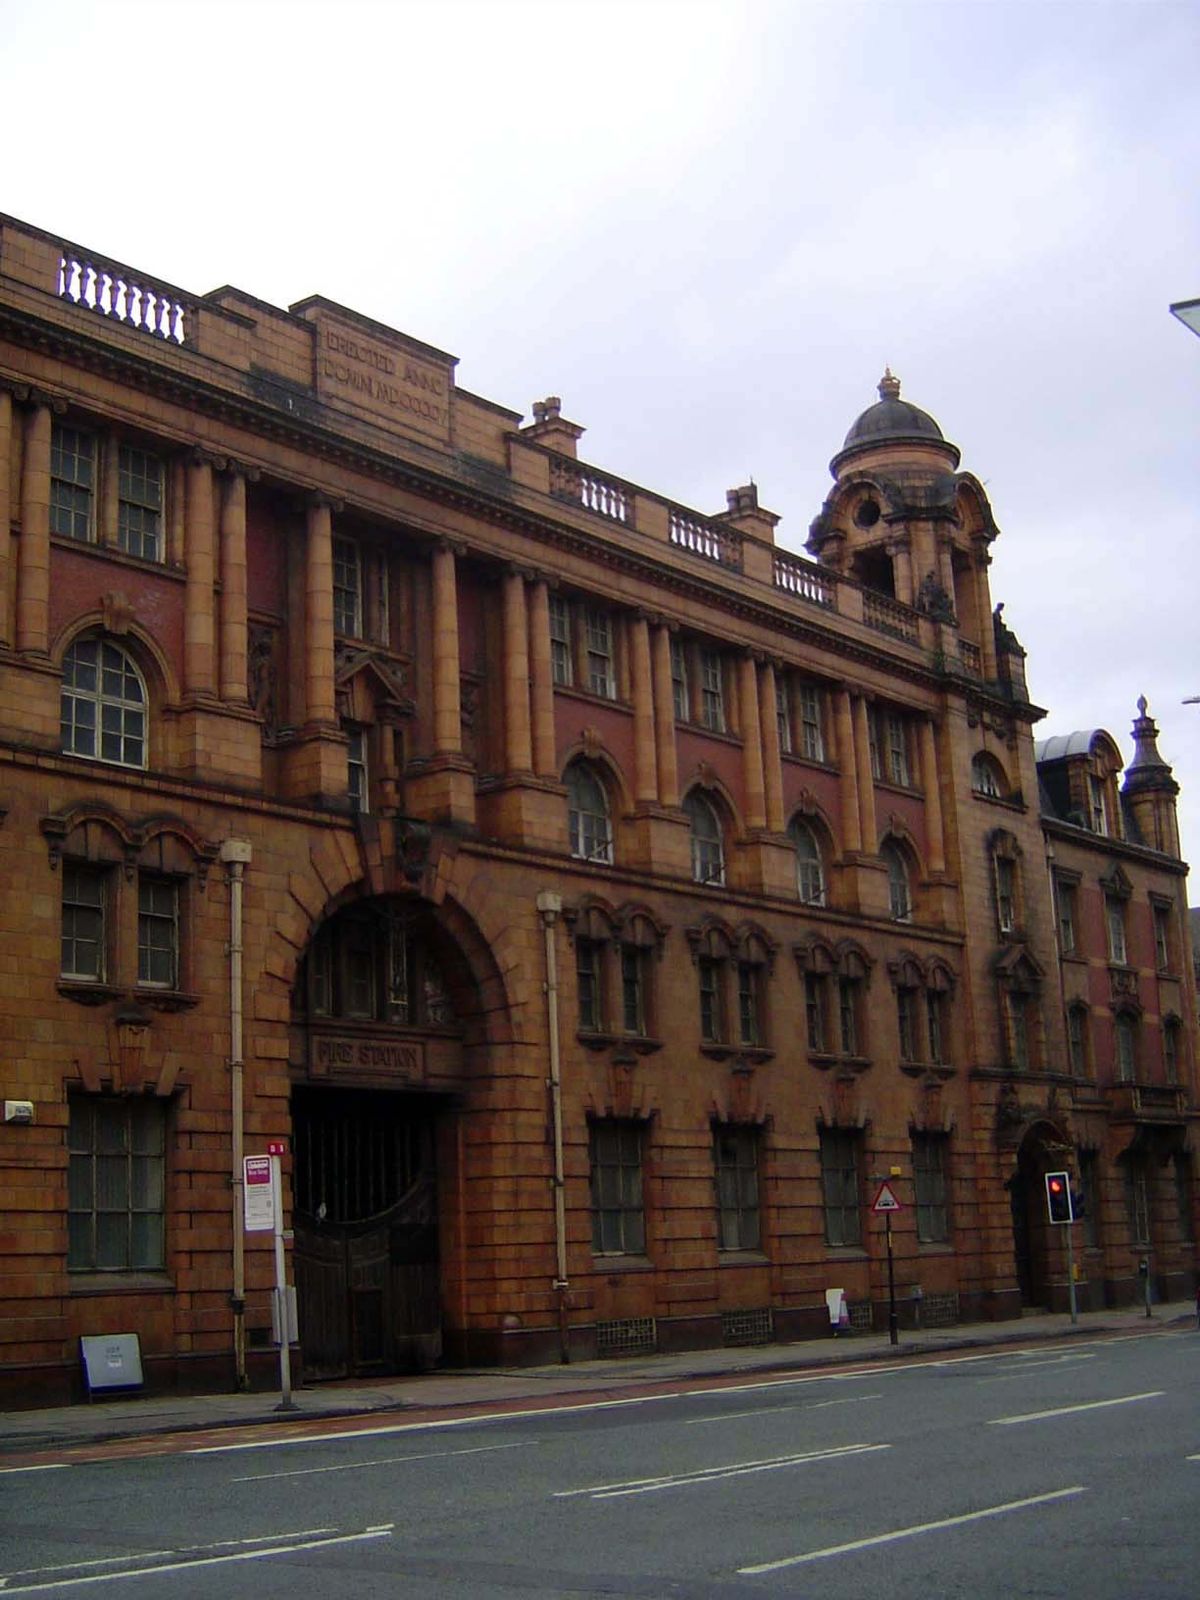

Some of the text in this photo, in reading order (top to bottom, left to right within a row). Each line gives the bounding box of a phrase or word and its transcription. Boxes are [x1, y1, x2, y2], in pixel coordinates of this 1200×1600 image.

[327, 331, 394, 375] ERECTED
[318, 1041, 418, 1067] FIRE STATION
